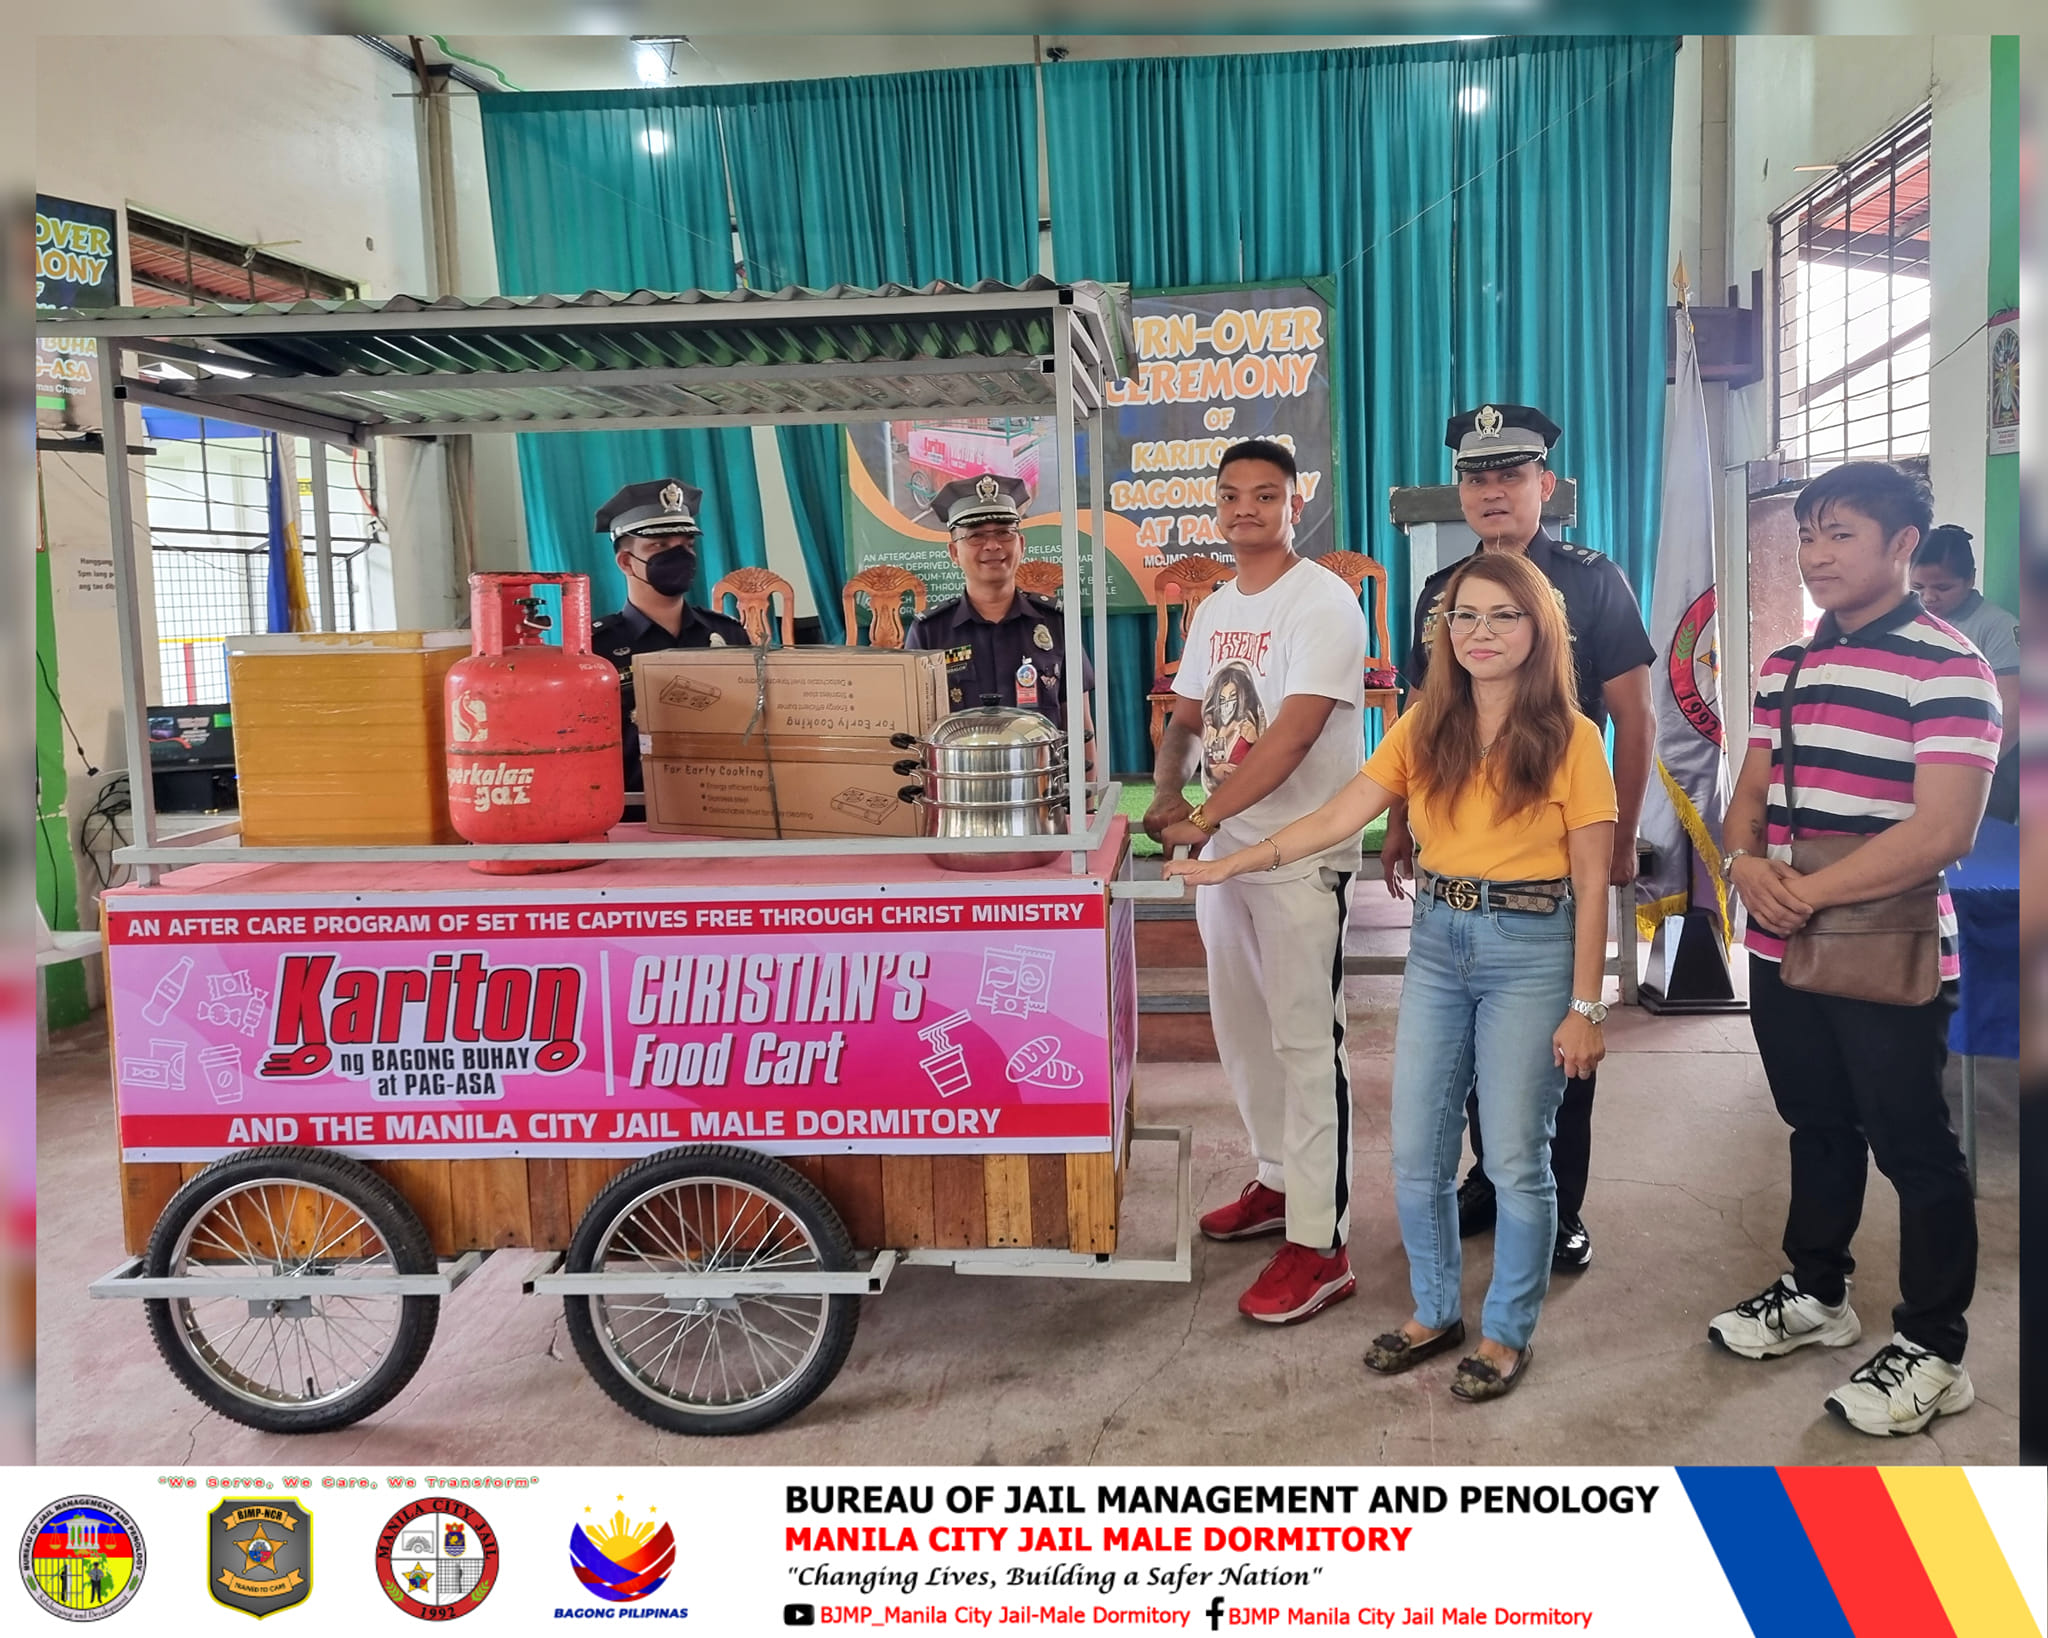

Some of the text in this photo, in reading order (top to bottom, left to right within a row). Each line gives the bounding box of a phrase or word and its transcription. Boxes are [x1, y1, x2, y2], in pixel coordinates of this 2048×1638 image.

[1133, 306, 1325, 360] RN-OVER
[1203, 407, 1236, 431] OF
[1136, 516, 1175, 547] AT
[878, 551, 927, 561] AFTERCARE
[905, 561, 950, 570] DEPRIVED
[1210, 552, 1236, 563] Dima
[786, 715, 896, 731] For Early Cooking
[1679, 691, 1718, 736] 1992
[663, 764, 764, 778] For Early Cooking
[474, 785, 532, 812] gaz
[128, 903, 1085, 936] AN AFTER CARE PROGRAM OF SET THE CAPTIVES FREE THROUGH CHRIST MINISTRY
[273, 953, 582, 1046] Kariton
[627, 951, 931, 1025] CHRISTIAN'S
[340, 1047, 530, 1075] ng BAGONG BUHAY
[628, 1030, 847, 1089] Food Cart
[378, 1073, 496, 1096] at PAG-ASA
[227, 1108, 1001, 1143] AND THE MANILA CITY JAIL MALE DORMITORY
